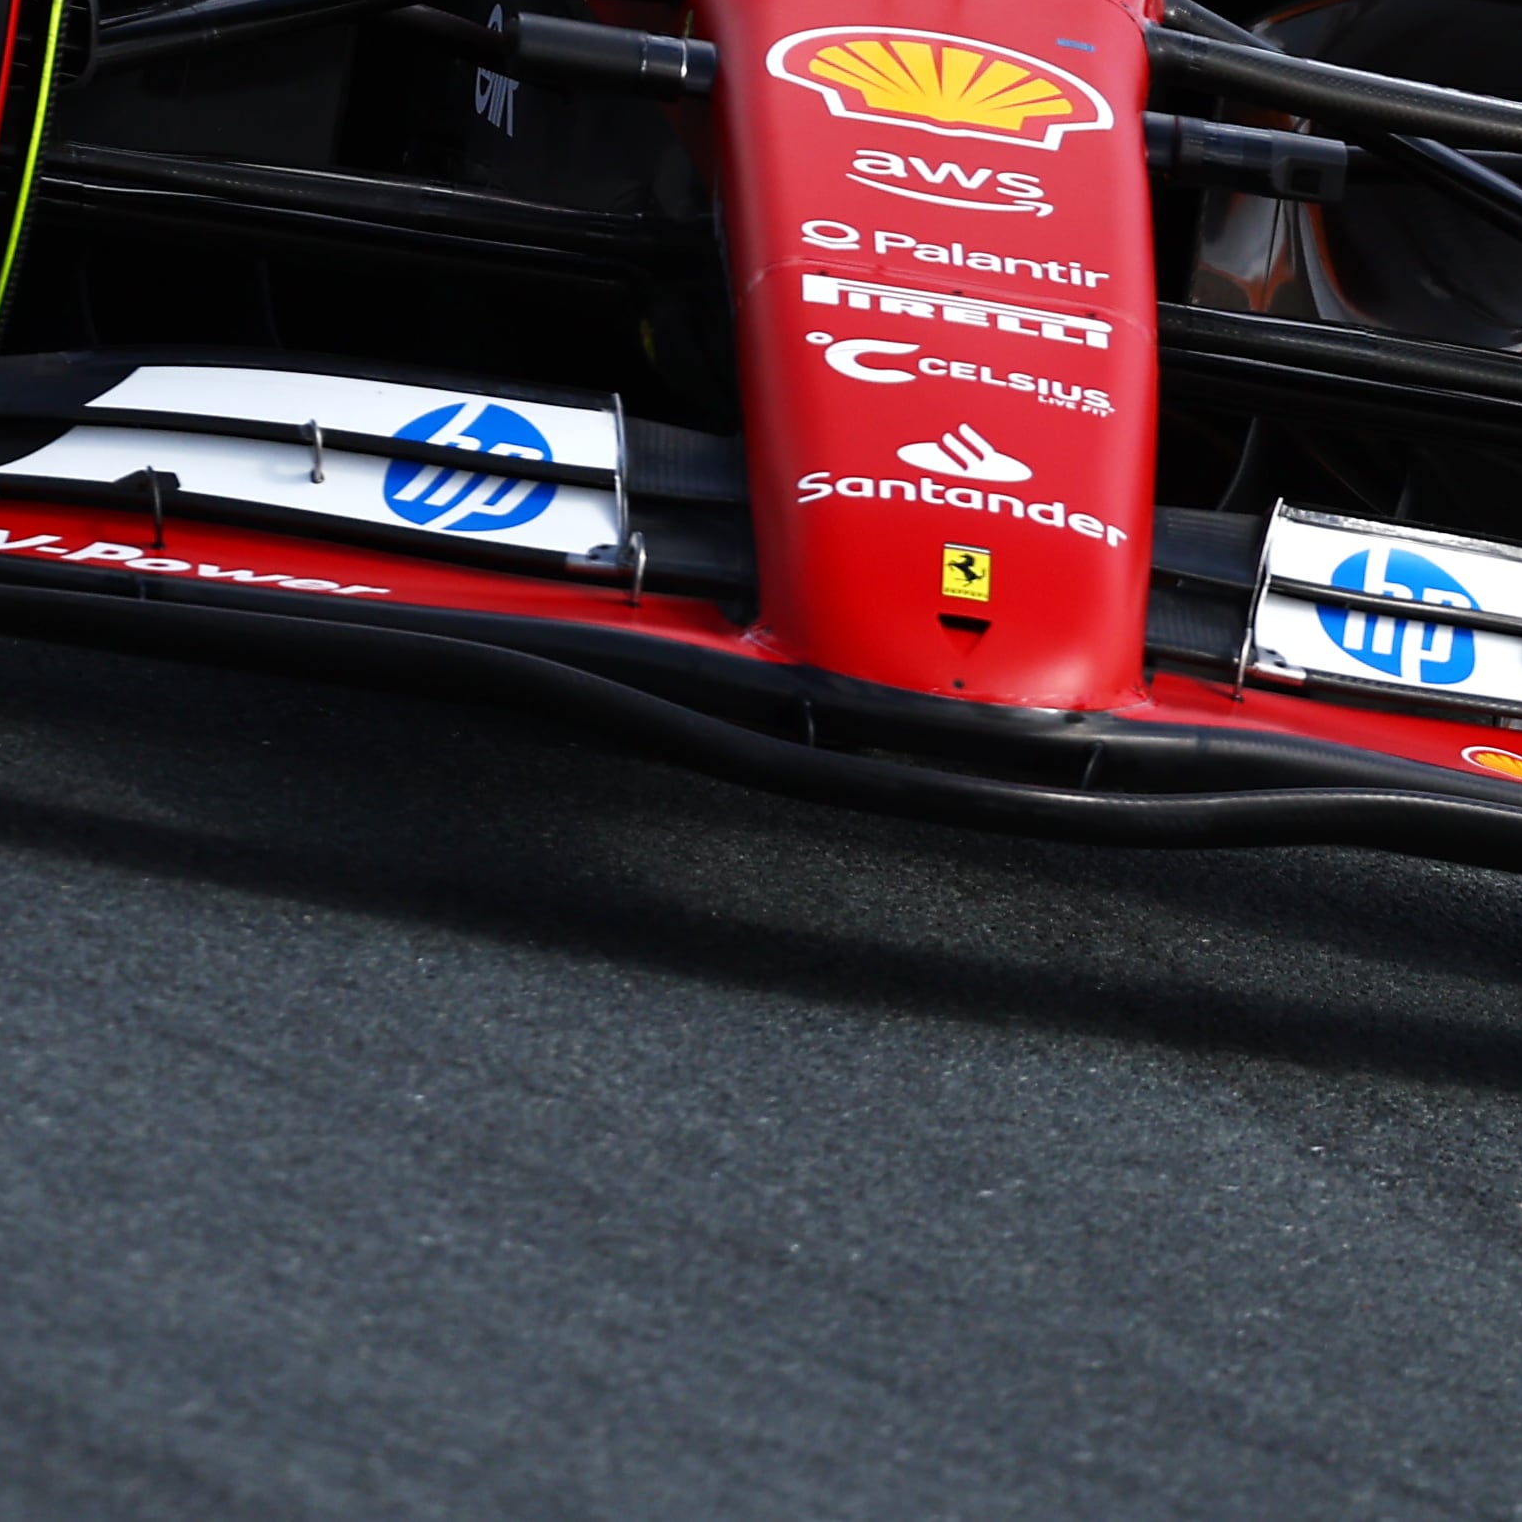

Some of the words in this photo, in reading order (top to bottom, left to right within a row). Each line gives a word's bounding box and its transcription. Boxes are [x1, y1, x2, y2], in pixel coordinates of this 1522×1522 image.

[852, 149, 1045, 200] aws
[874, 230, 1110, 288] Palantir
[801, 273, 1113, 349] PIRELLI
[918, 357, 1112, 410] CELSIUS
[1038, 394, 1077, 411] LIVE
[1080, 404, 1112, 418] FIT
[391, 401, 546, 531] hp
[797, 471, 1128, 547] Santander
[1341, 547, 1473, 684] hp
